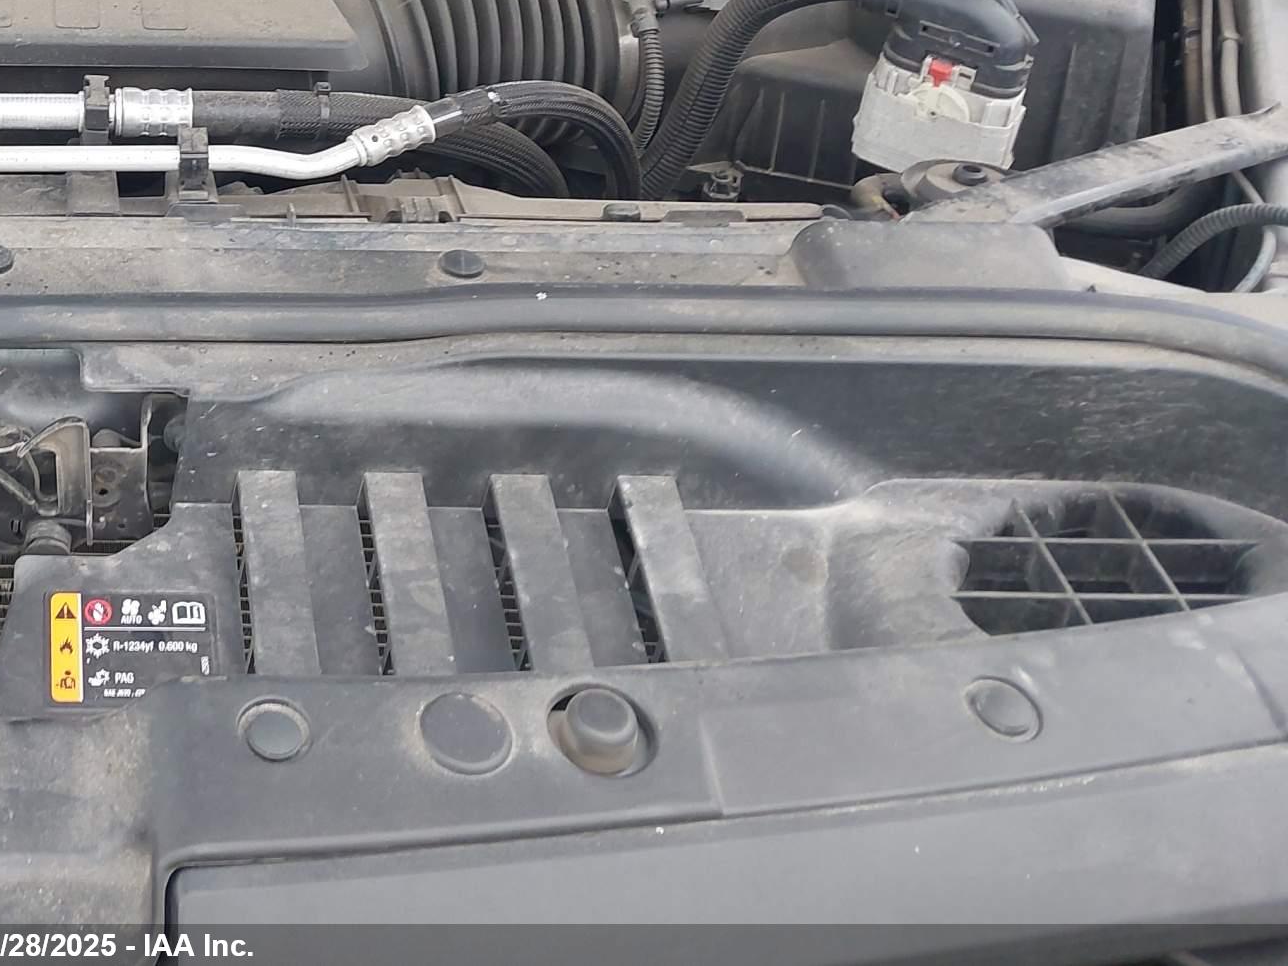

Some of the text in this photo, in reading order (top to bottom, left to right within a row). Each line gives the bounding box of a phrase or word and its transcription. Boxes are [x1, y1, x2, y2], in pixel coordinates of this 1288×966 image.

[120, 614, 143, 624] AUTO
[113, 640, 154, 654] R-1234yf
[185, 640, 198, 654] kg
[114, 671, 135, 684] PAG
